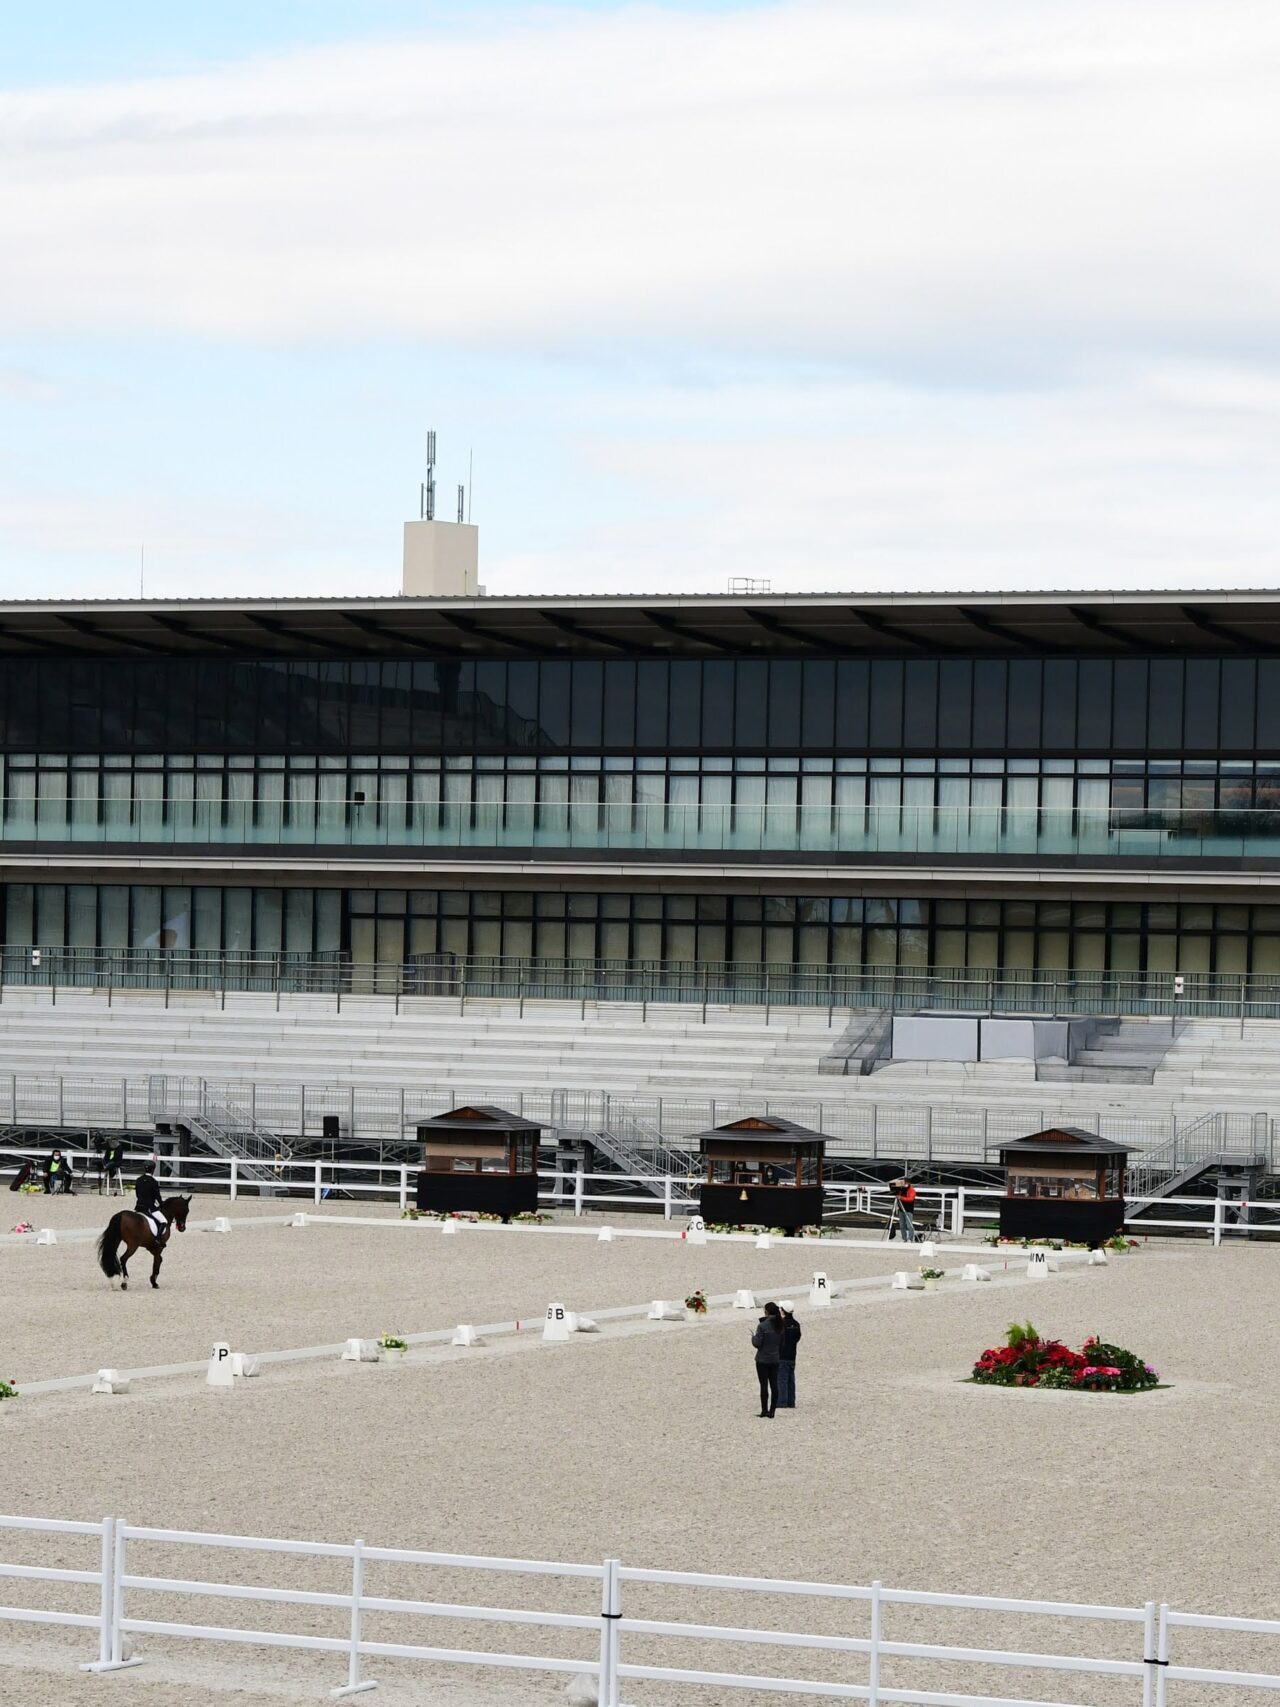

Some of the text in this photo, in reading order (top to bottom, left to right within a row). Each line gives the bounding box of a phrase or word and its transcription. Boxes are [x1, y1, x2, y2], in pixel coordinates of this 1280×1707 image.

[696, 1221, 703, 1231] C
[1035, 1253, 1045, 1263] M
[818, 1278, 826, 1289] R
[555, 1308, 564, 1320] B
[218, 1349, 228, 1361] P
